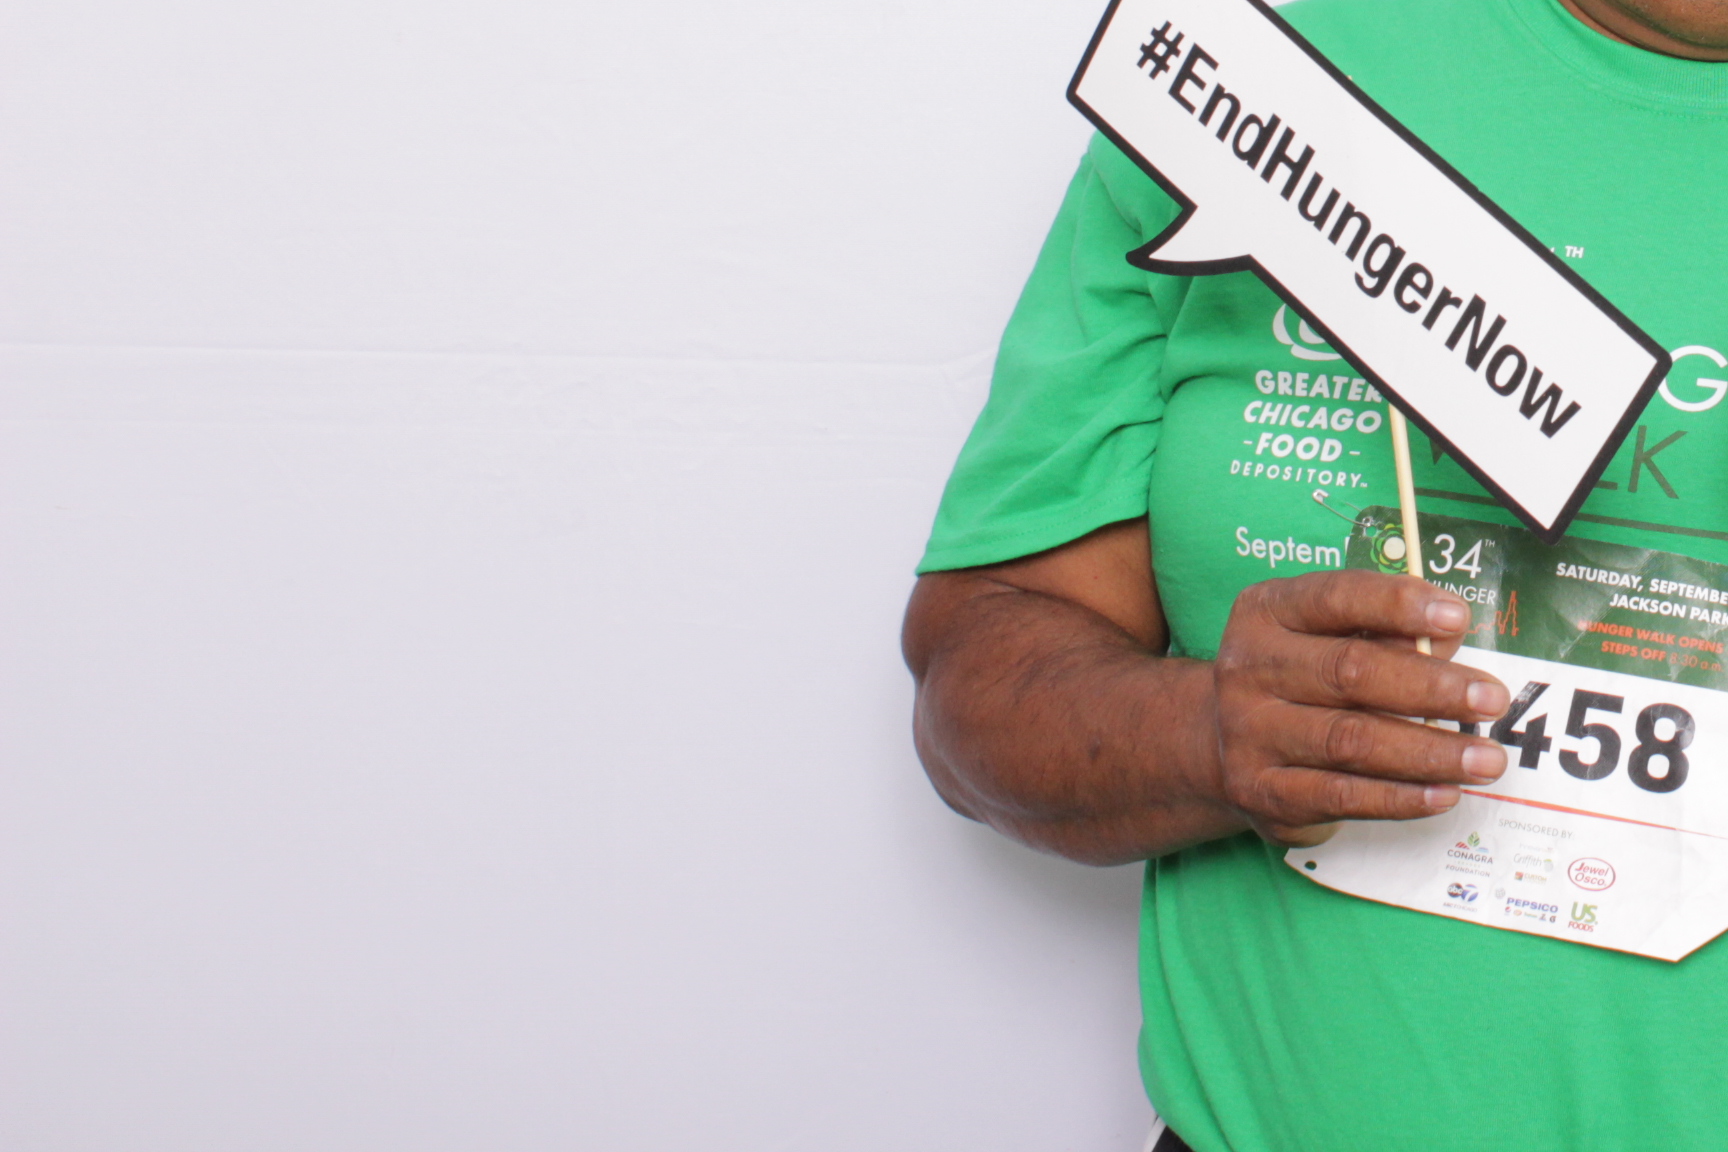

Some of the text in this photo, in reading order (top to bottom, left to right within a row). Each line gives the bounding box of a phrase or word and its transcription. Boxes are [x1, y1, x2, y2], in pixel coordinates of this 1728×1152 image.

[1136, 20, 1581, 439] #EndHungerNow
[1255, 369, 1383, 403] GREATER
[1243, 400, 1382, 434] CHICAGO
[1236, 526, 1350, 568] Septem
[1556, 562, 1643, 592] SATURDAY,
[1426, 579, 1497, 605] NGER
[1609, 593, 1686, 619] JACKSON
[1601, 641, 1638, 658] STEPS
[1641, 648, 1667, 662] OFF
[1636, 628, 1676, 645] WALK
[1678, 636, 1725, 654] OPENS
[1459, 680, 1695, 793] 458
[1498, 818, 1558, 836] SPONSORED
[1447, 849, 1494, 864] CONAGRA
[1574, 862, 1609, 877] Jewel
[1445, 864, 1491, 878] FOUNDATION
[1506, 897, 1558, 913] PEPSICO
[1568, 920, 1594, 932] FOODS
